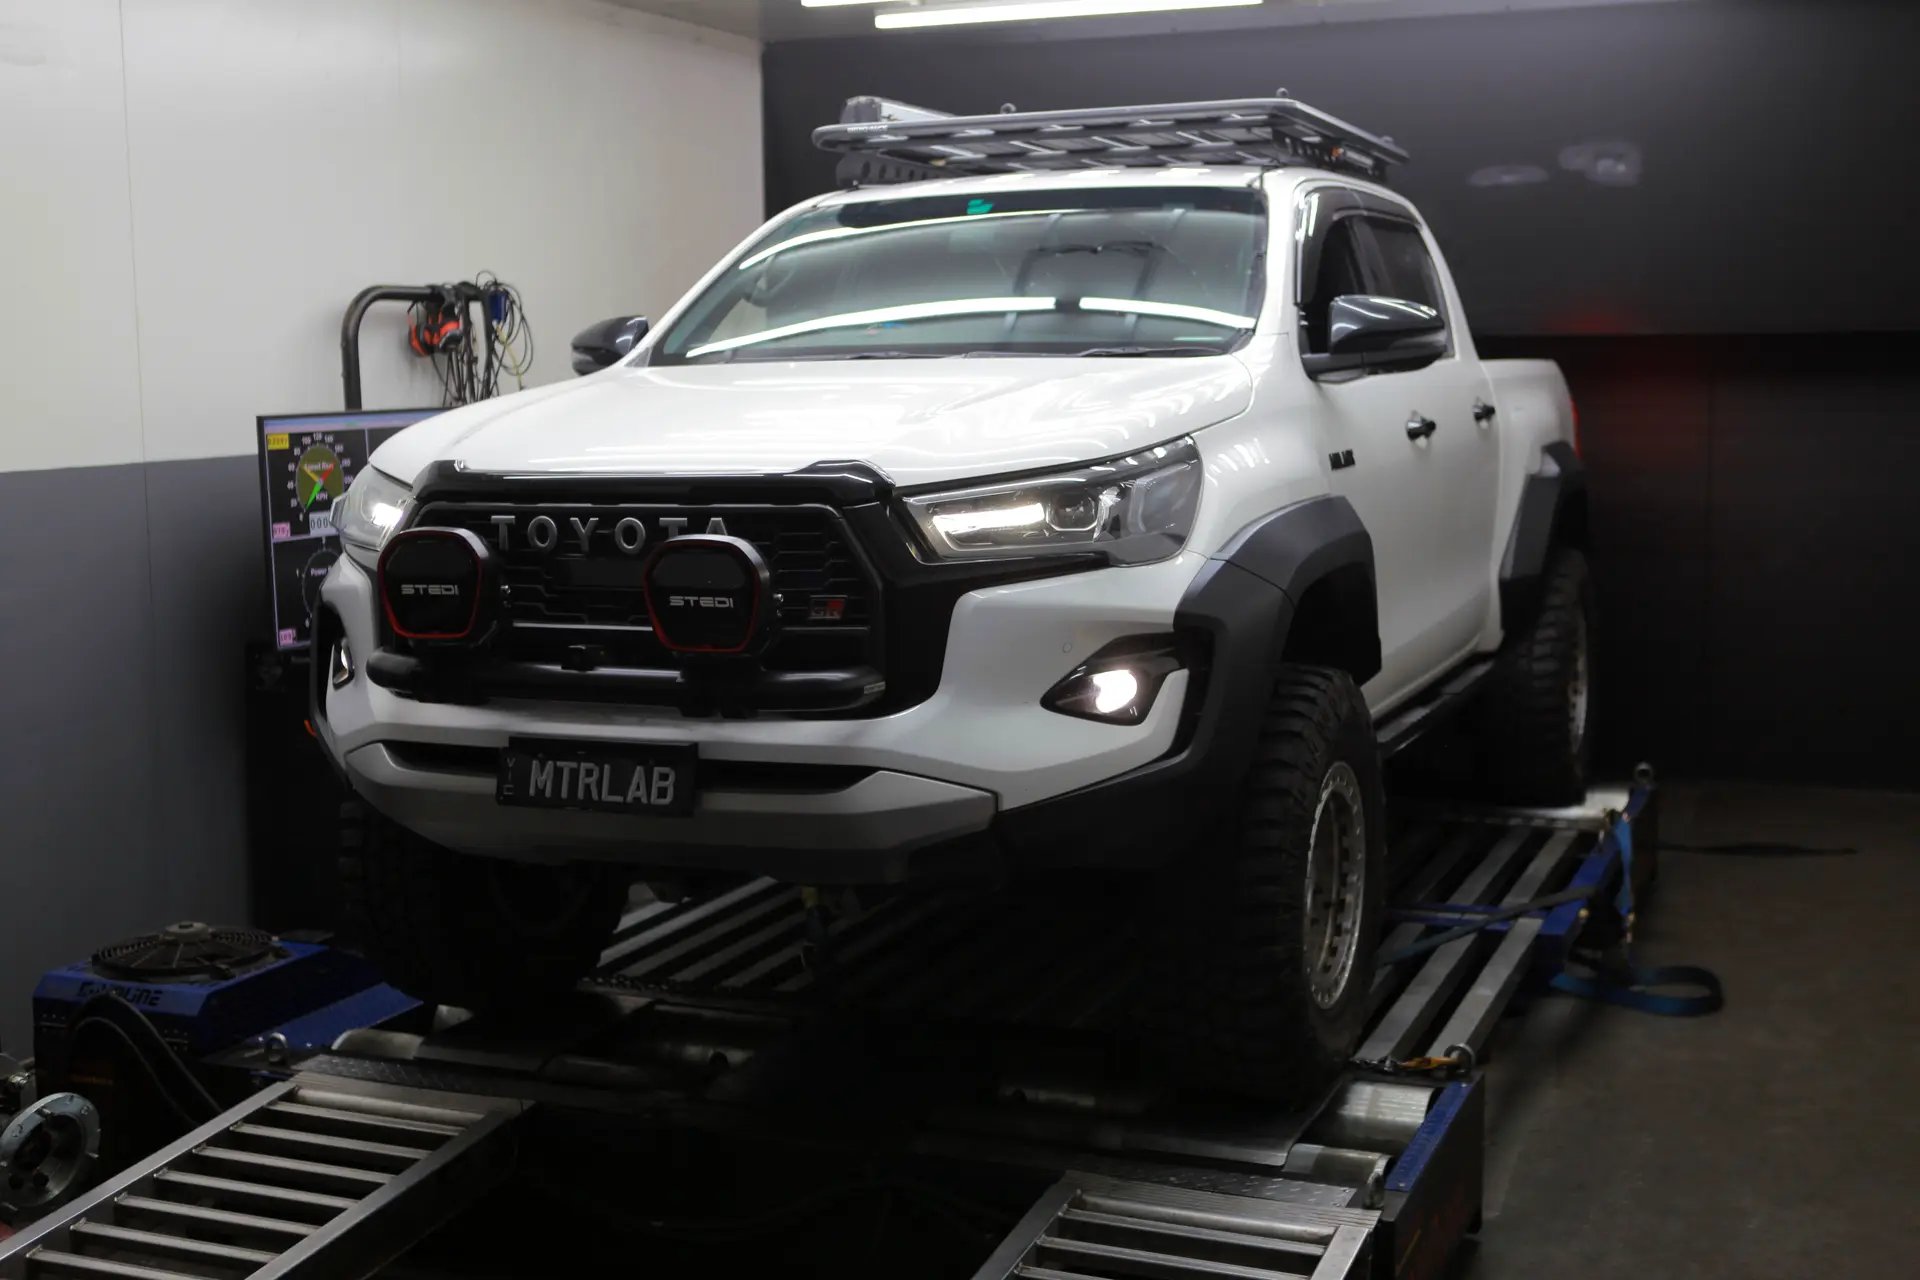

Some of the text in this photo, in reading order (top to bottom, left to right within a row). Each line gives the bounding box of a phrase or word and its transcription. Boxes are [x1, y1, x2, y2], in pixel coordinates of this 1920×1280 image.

[400, 584, 459, 597] STEDI
[669, 596, 734, 609] STEDI
[528, 759, 676, 806] MTRLAB
